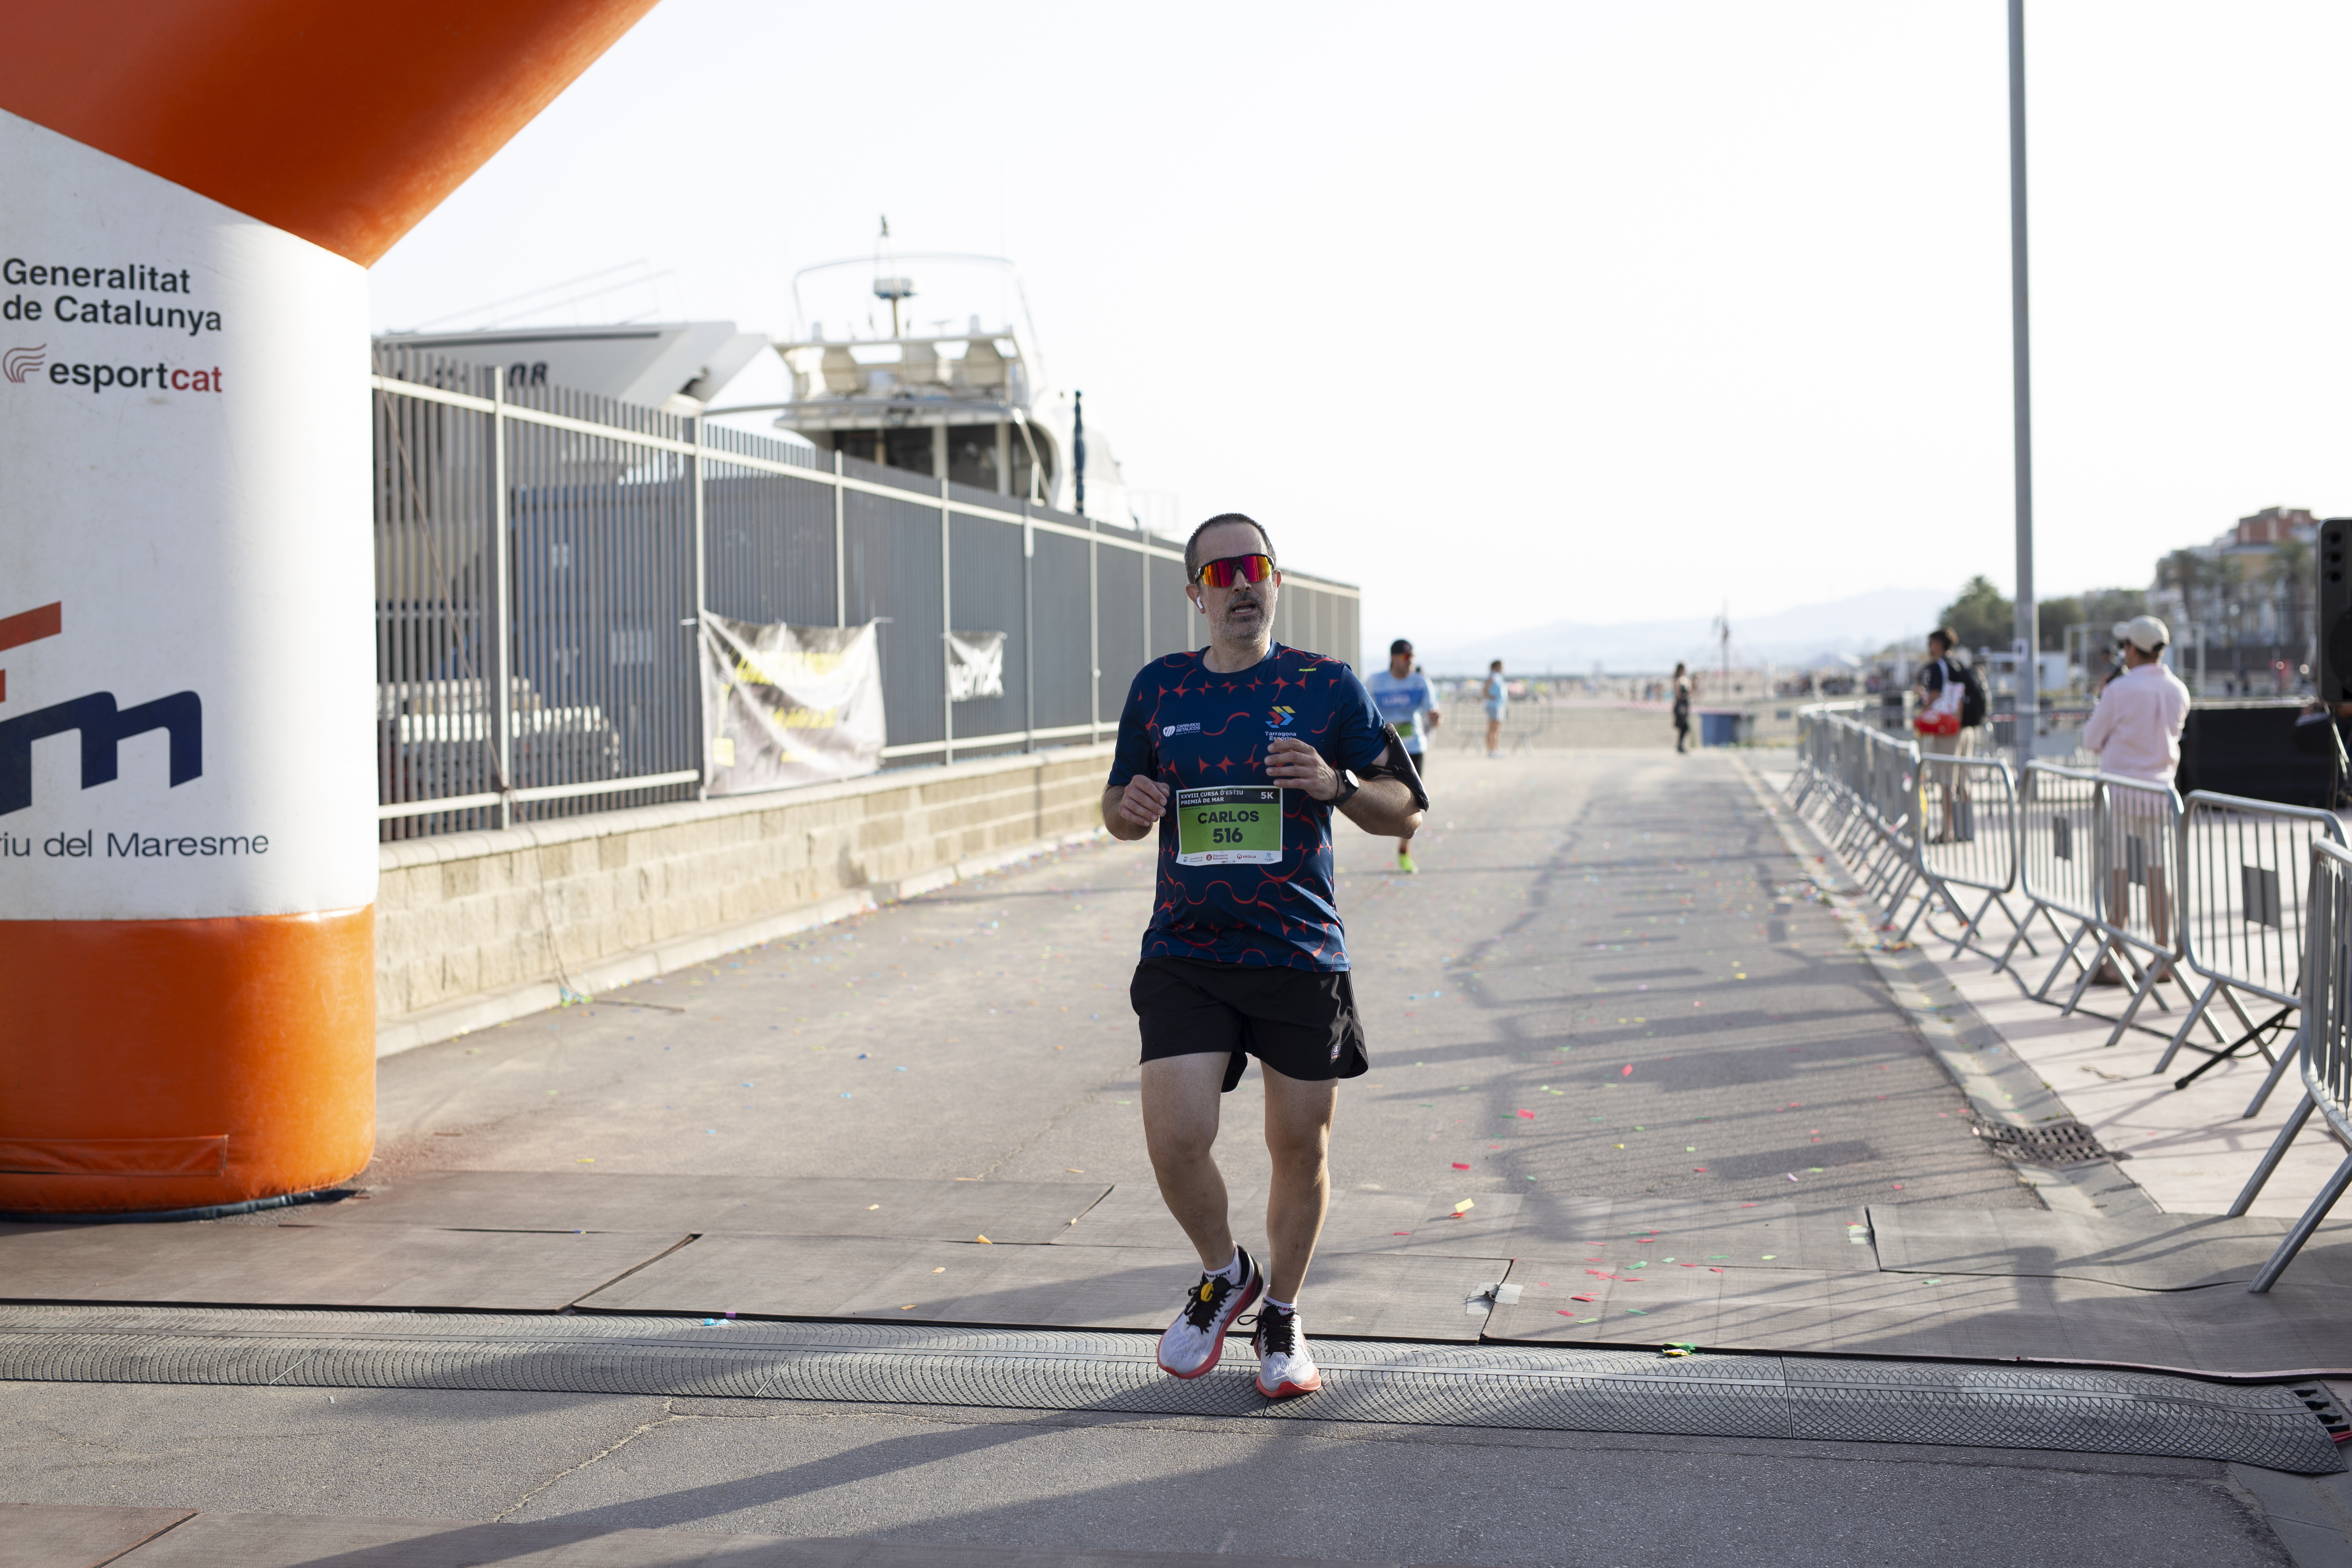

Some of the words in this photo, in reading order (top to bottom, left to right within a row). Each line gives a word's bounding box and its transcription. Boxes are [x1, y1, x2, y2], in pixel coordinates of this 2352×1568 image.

[3, 257, 191, 294] Generalitat
[3, 294, 42, 320] de
[54, 295, 222, 337] Catalunya
[49, 362, 222, 393] esportcat
[1197, 810, 1259, 824] CARLOS
[44, 828, 92, 857] del
[107, 832, 269, 857] Maresme
[1213, 827, 1243, 843] 516
